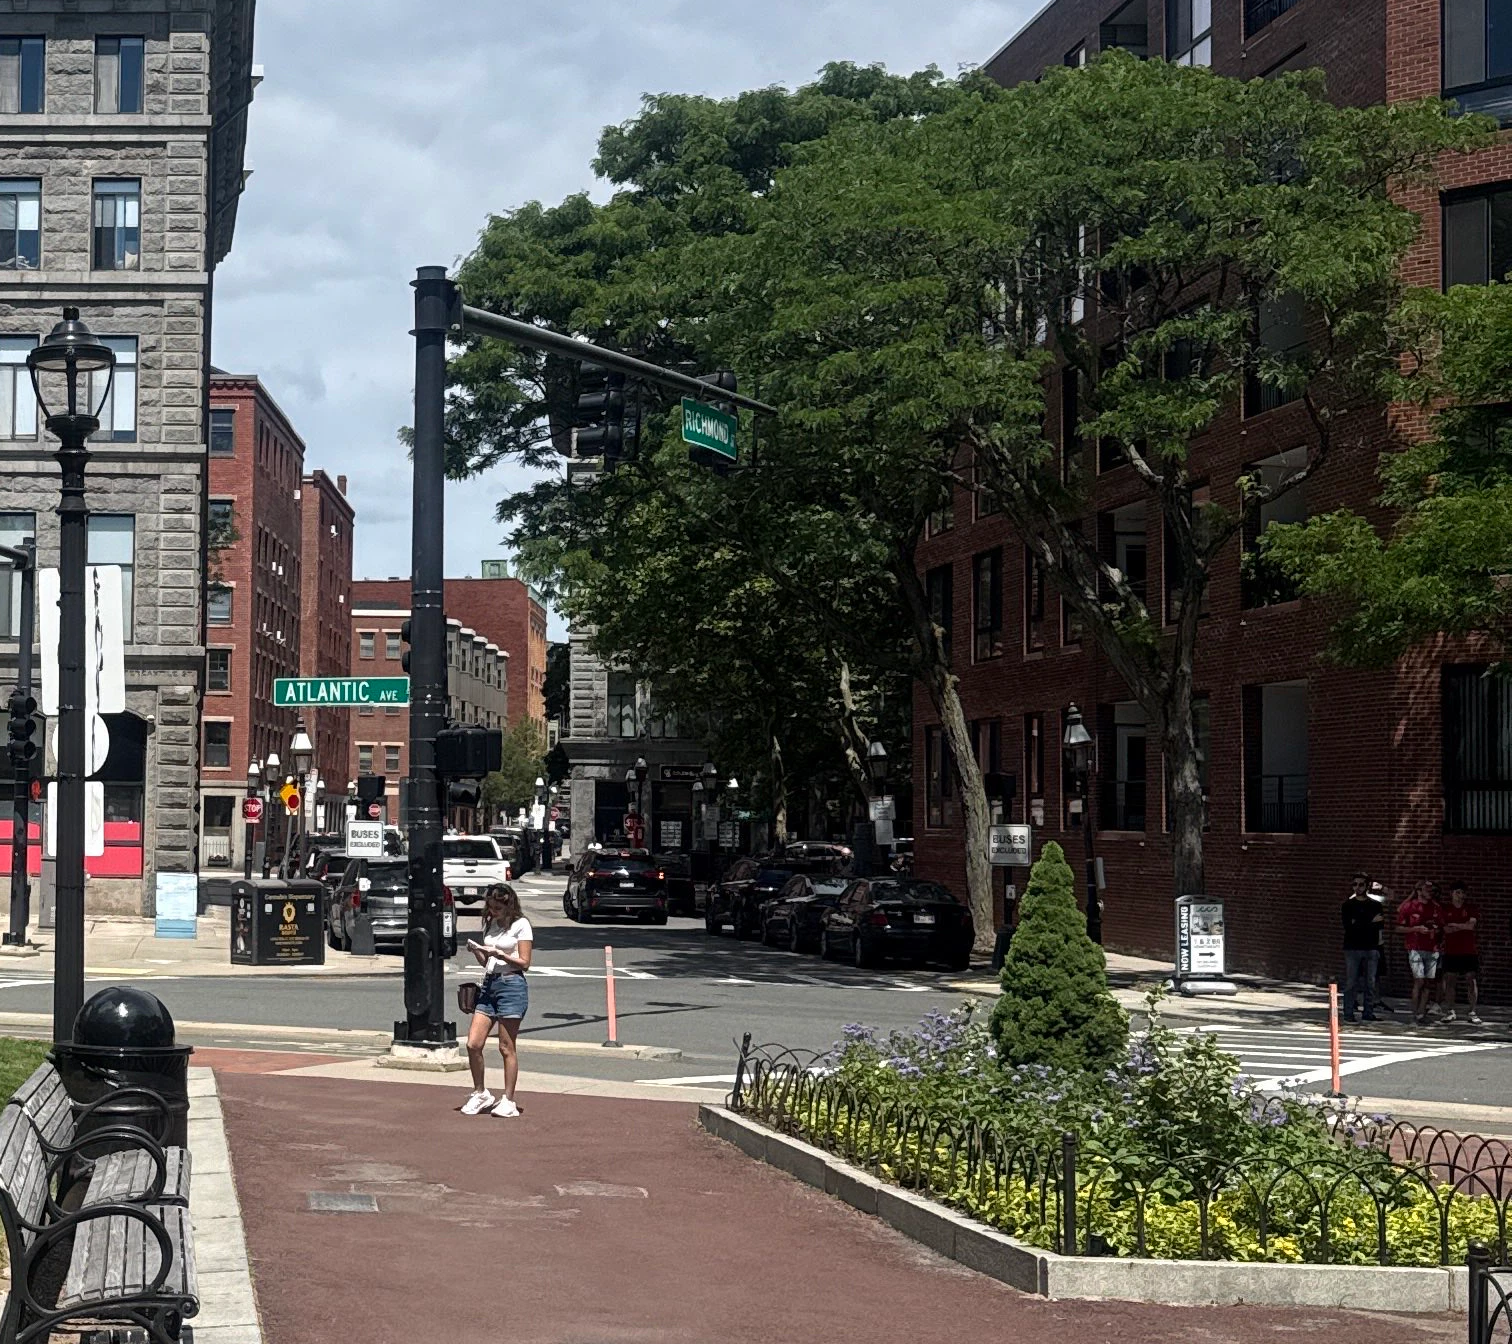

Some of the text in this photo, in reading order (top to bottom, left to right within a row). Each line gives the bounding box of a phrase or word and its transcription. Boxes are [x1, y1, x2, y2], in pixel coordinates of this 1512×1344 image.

[685, 409, 729, 445] RICHMOND
[285, 681, 399, 702] ATLANTIC AVE
[243, 803, 262, 812] STOP
[351, 829, 380, 839] BUSES
[992, 834, 1026, 844] BUSES
[991, 847, 1027, 855] EXCLUDED
[1180, 906, 1190, 971] NOW LEASING
